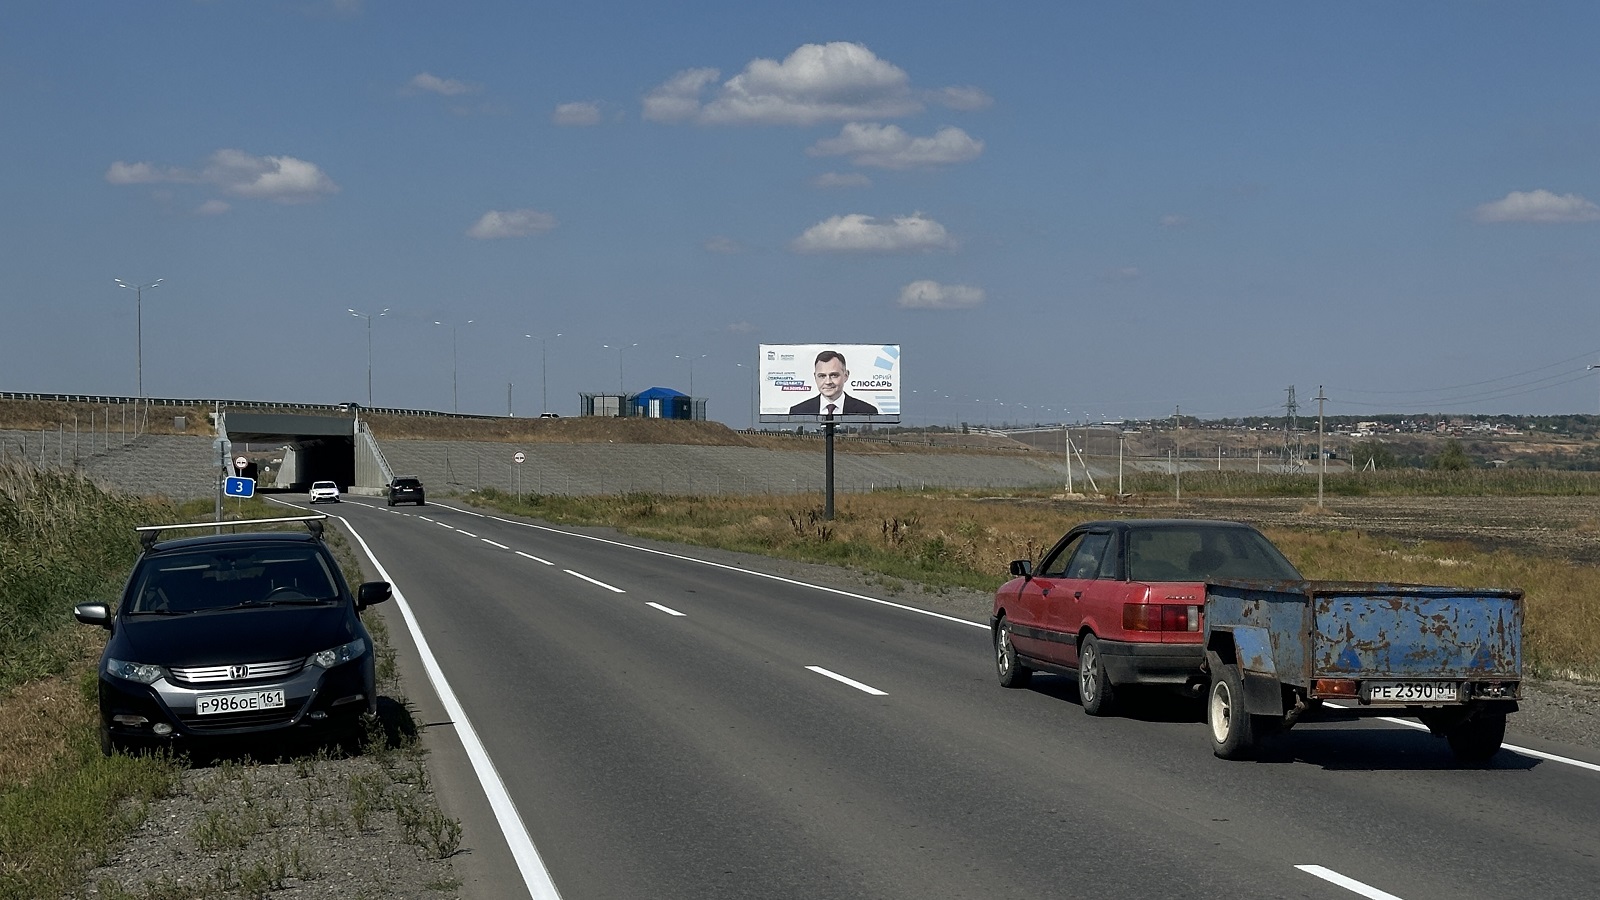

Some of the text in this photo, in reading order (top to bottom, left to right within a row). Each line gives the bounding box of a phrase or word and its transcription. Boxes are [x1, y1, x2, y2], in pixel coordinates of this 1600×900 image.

[236, 481, 243, 493] 3
[1395, 683, 1433, 698] 2390
[1437, 682, 1451, 694] 61
[260, 692, 281, 703] 161
